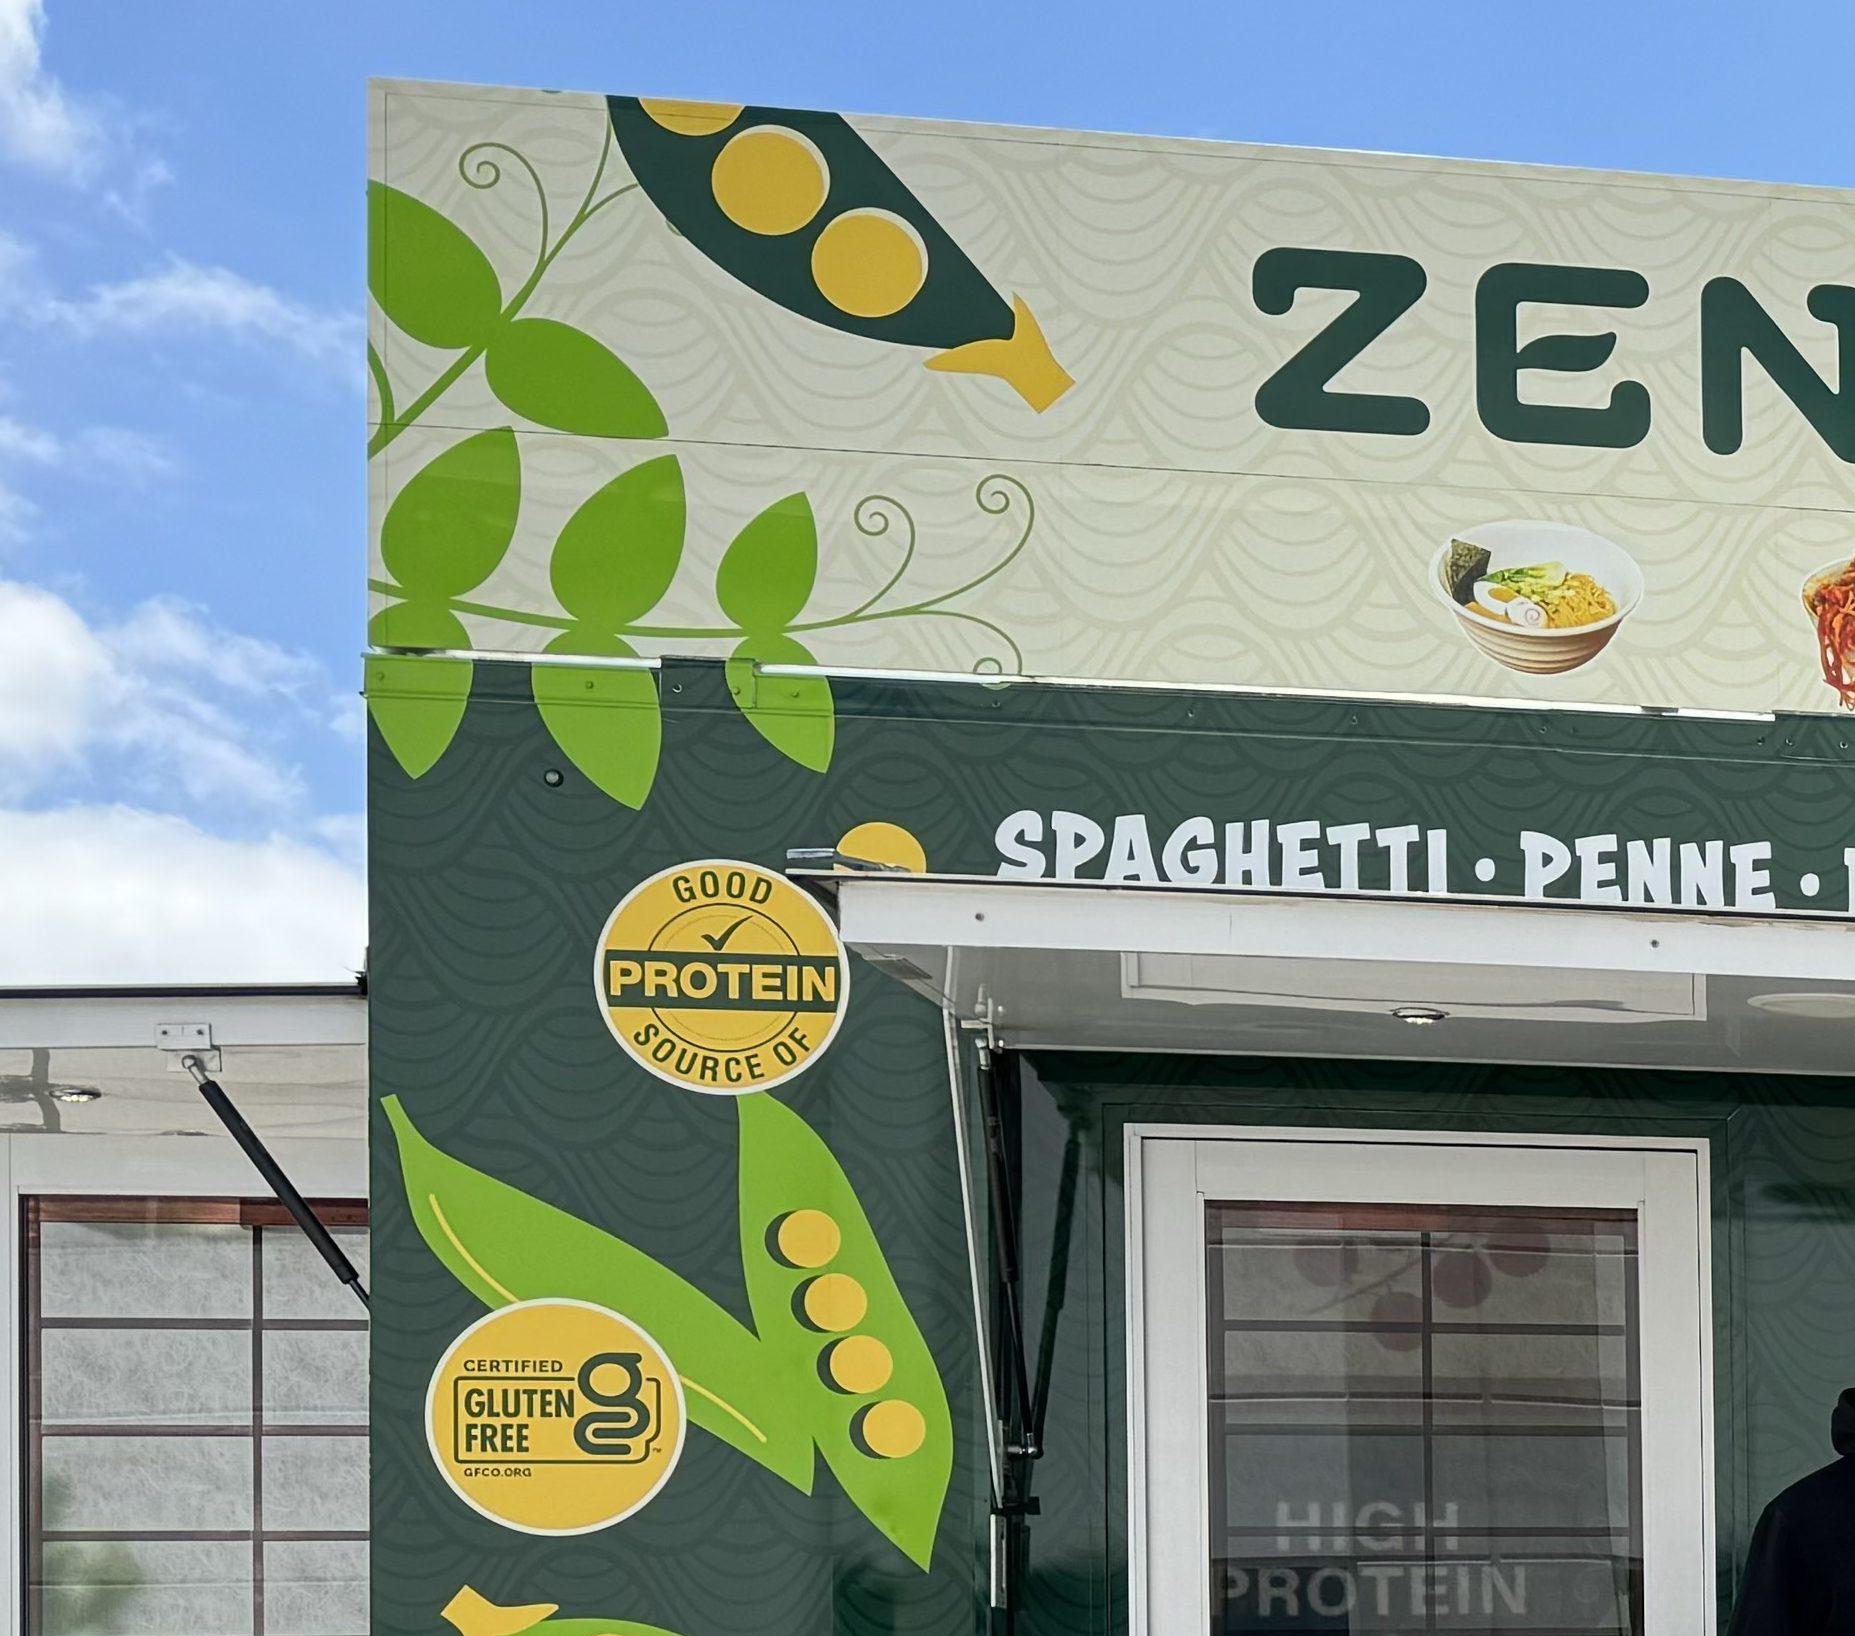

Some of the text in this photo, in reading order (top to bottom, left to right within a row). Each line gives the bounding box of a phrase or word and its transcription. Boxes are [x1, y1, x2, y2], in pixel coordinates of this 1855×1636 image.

[995, 810, 1447, 892] SPAGHETTI
[1520, 831, 1775, 908] PENNE
[672, 870, 774, 906] GOOD
[609, 959, 836, 1002] PROTEIN
[633, 1022, 813, 1083] SOURCE OF
[463, 1359, 563, 1373] CERTIFIED
[464, 1388, 574, 1418] GLUTEN
[465, 1423, 530, 1453] FREE
[464, 1467, 532, 1478] GFCO.ORG
[1276, 1501, 1459, 1551] HIGH
[1212, 1566, 1527, 1617] PROTEIN
